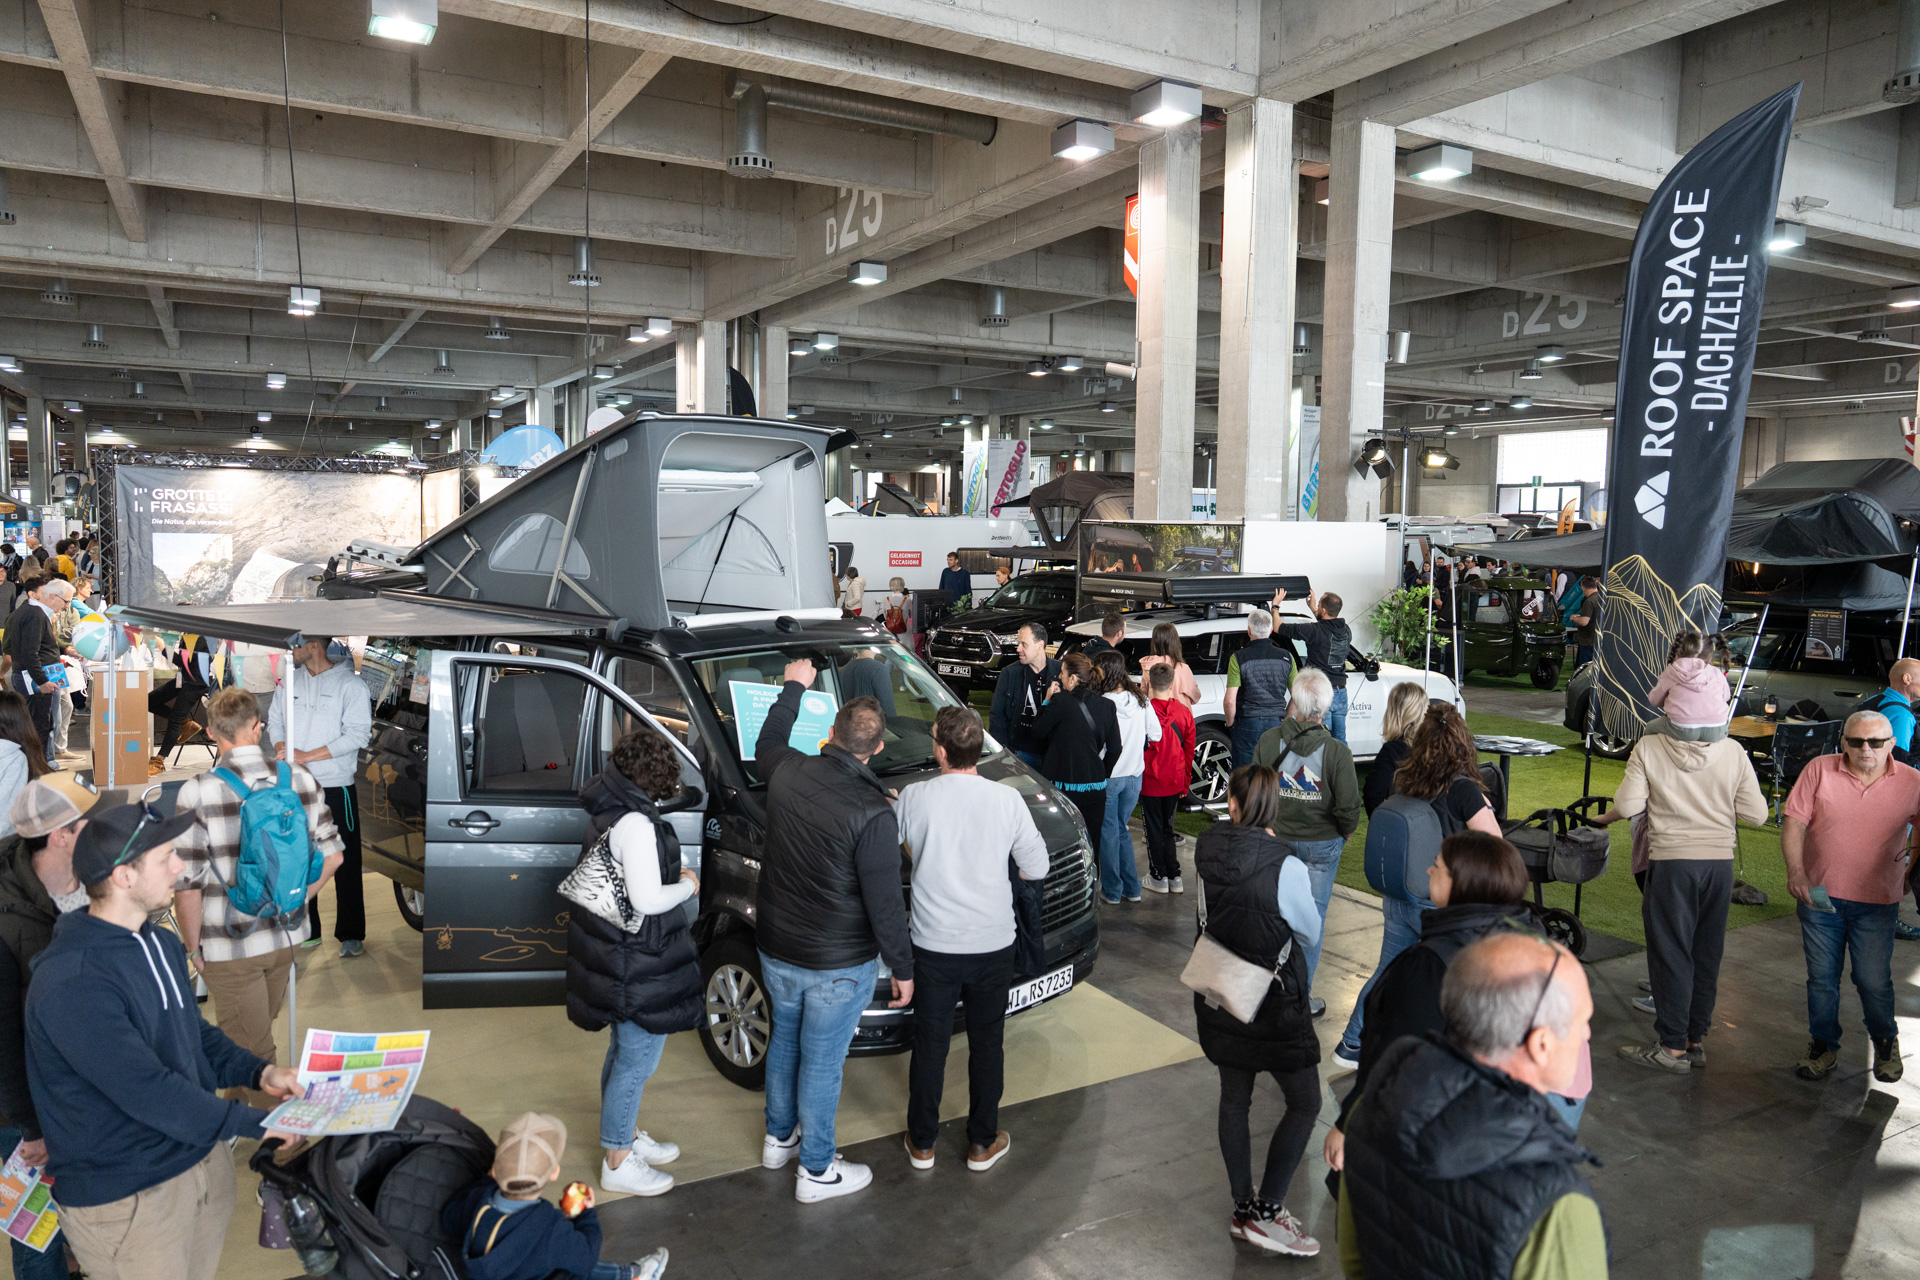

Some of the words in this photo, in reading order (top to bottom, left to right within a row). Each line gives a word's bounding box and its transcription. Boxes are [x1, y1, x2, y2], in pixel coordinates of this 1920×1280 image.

[825, 186, 884, 256] D25
[1658, 188, 1710, 325] SPACE
[1502, 291, 1588, 339] D25
[1690, 254, 1748, 411] DACHZELTE
[1640, 336, 1687, 457] ROOF
[152, 488, 215, 501] GROTTE
[990, 440, 1027, 519] BERTOGLIO
[150, 501, 234, 514] FRASASSI
[939, 664, 952, 673] ROOF
[953, 666, 969, 675] SPACE
[1021, 683, 1038, 717] A
[1349, 701, 1372, 711] Activa
[1030, 980, 1045, 1001] RS
[1046, 967, 1072, 995] 7233
